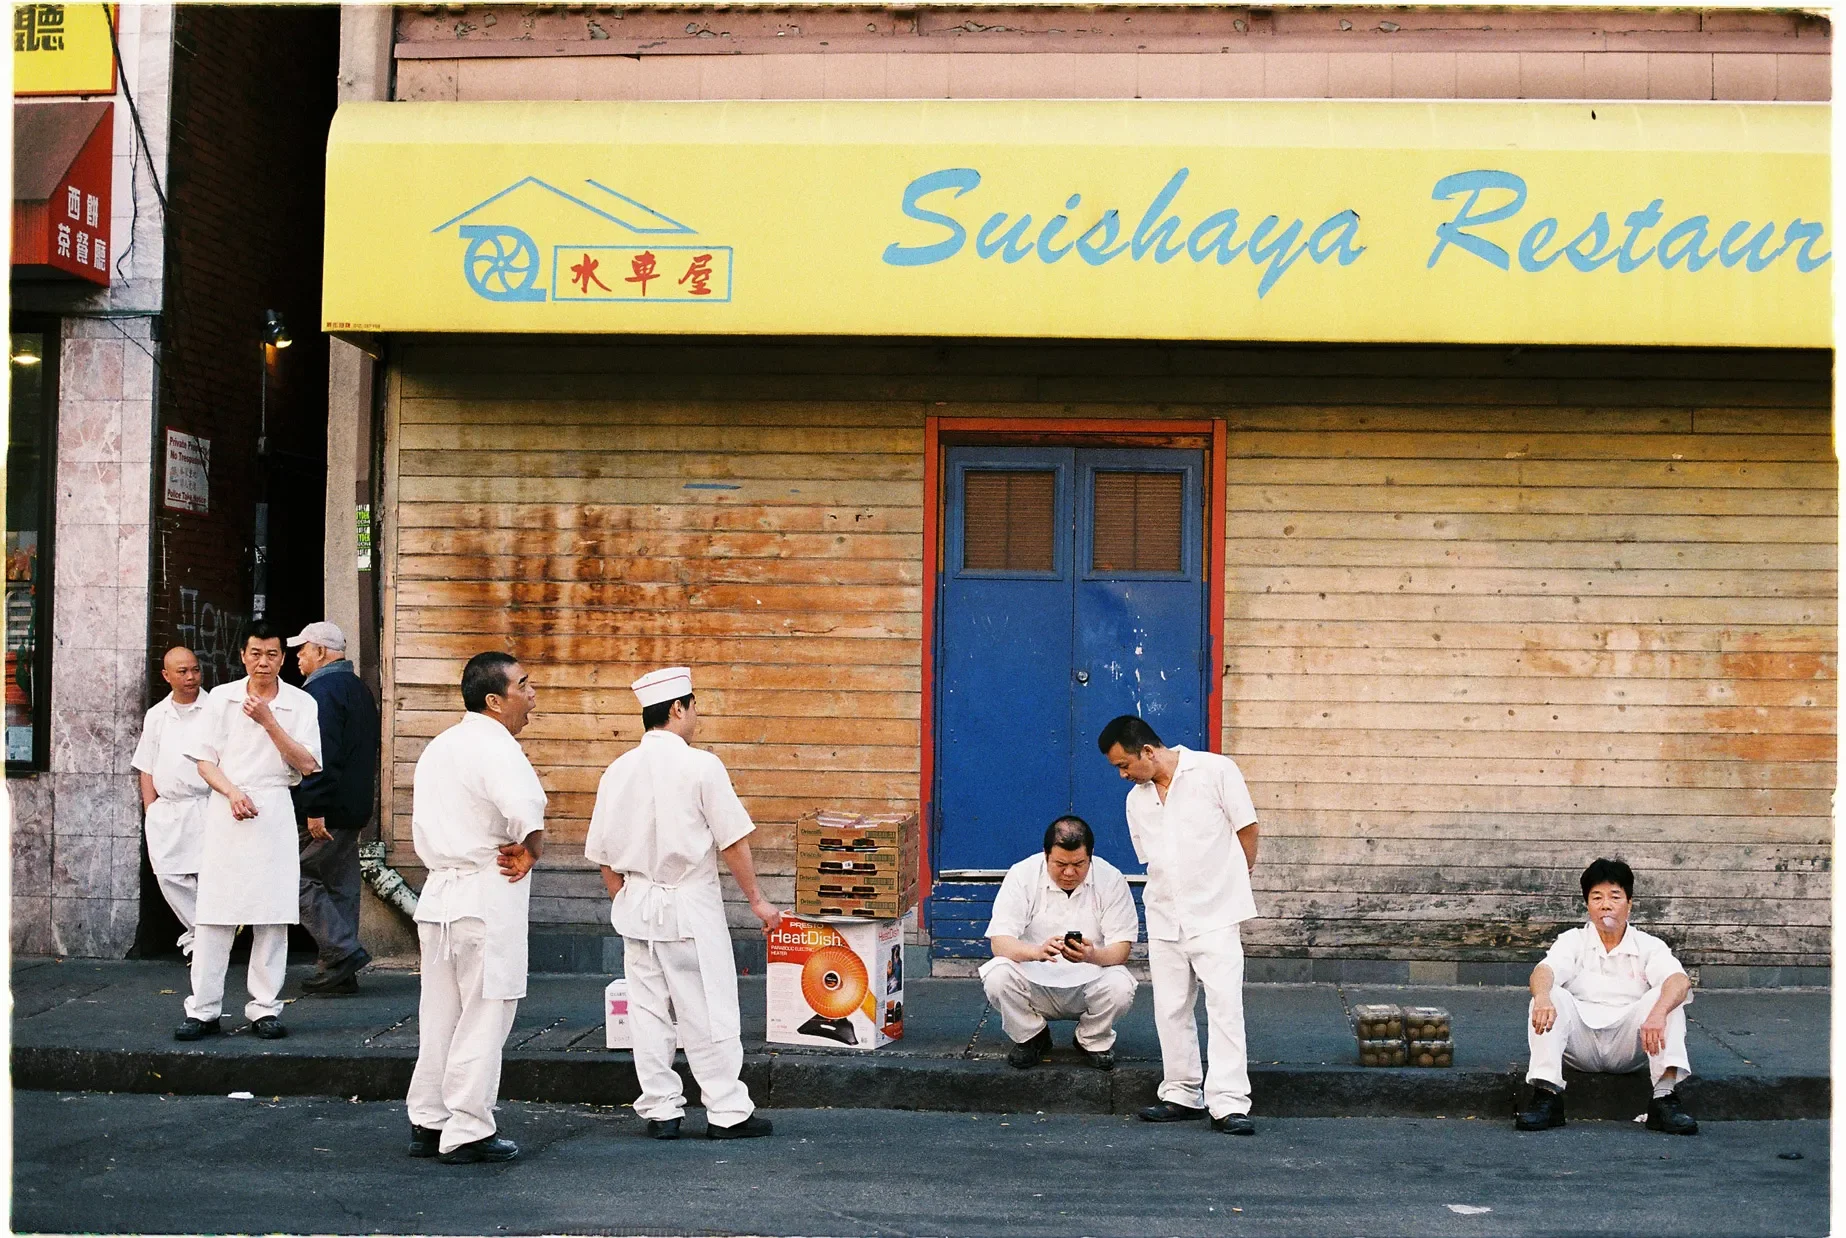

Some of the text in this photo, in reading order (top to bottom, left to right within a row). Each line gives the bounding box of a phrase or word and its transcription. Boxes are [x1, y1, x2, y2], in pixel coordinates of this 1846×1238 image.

[882, 167, 1832, 300] Suishaya Restaur
[571, 250, 713, 296] 水車屋
[169, 436, 187, 449] Private
[170, 450, 177, 460] No
[167, 488, 182, 499] Police
[182, 492, 192, 502] Take
[789, 921, 824, 930] PRESTO
